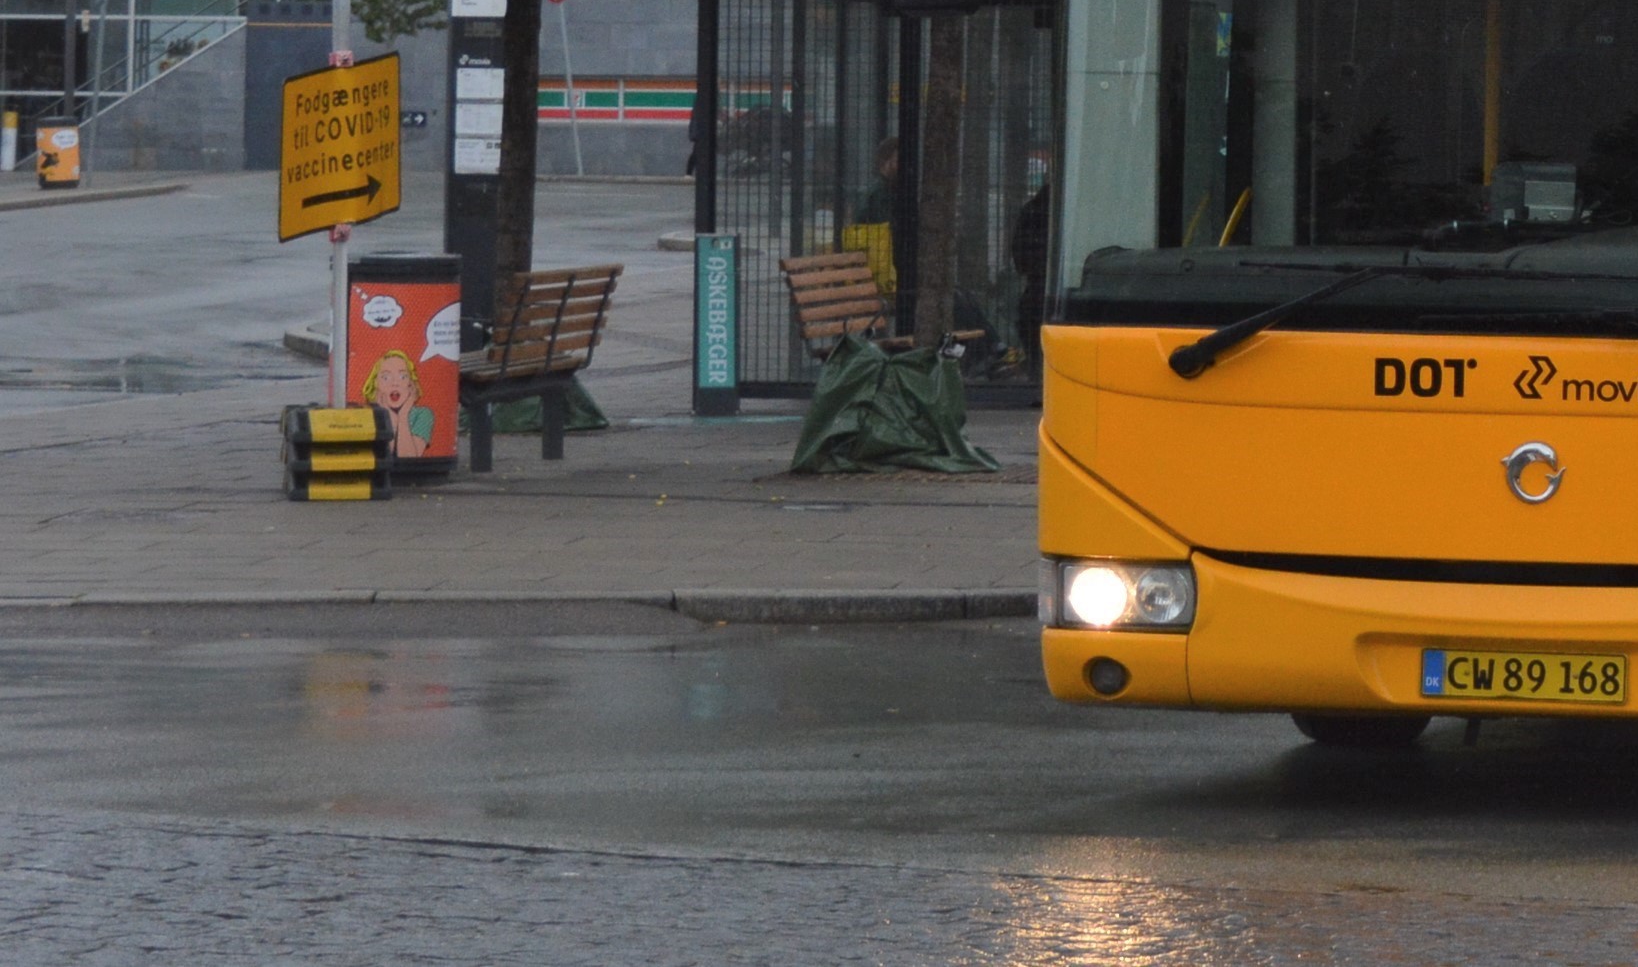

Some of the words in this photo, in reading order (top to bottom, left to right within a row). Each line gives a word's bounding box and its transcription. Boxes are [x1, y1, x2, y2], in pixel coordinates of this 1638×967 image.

[296, 80, 389, 117] Fodgængere
[293, 125, 309, 150] til
[315, 105, 390, 143] COVID-19
[287, 141, 394, 184] vaccinecenter
[706, 256, 727, 384] ASKEBÆGER
[1374, 357, 1477, 397] DOT
[1426, 677, 1439, 687] DK
[1448, 657, 1495, 690] CW
[1503, 658, 1546, 693] 89
[1560, 661, 1620, 696] 168
